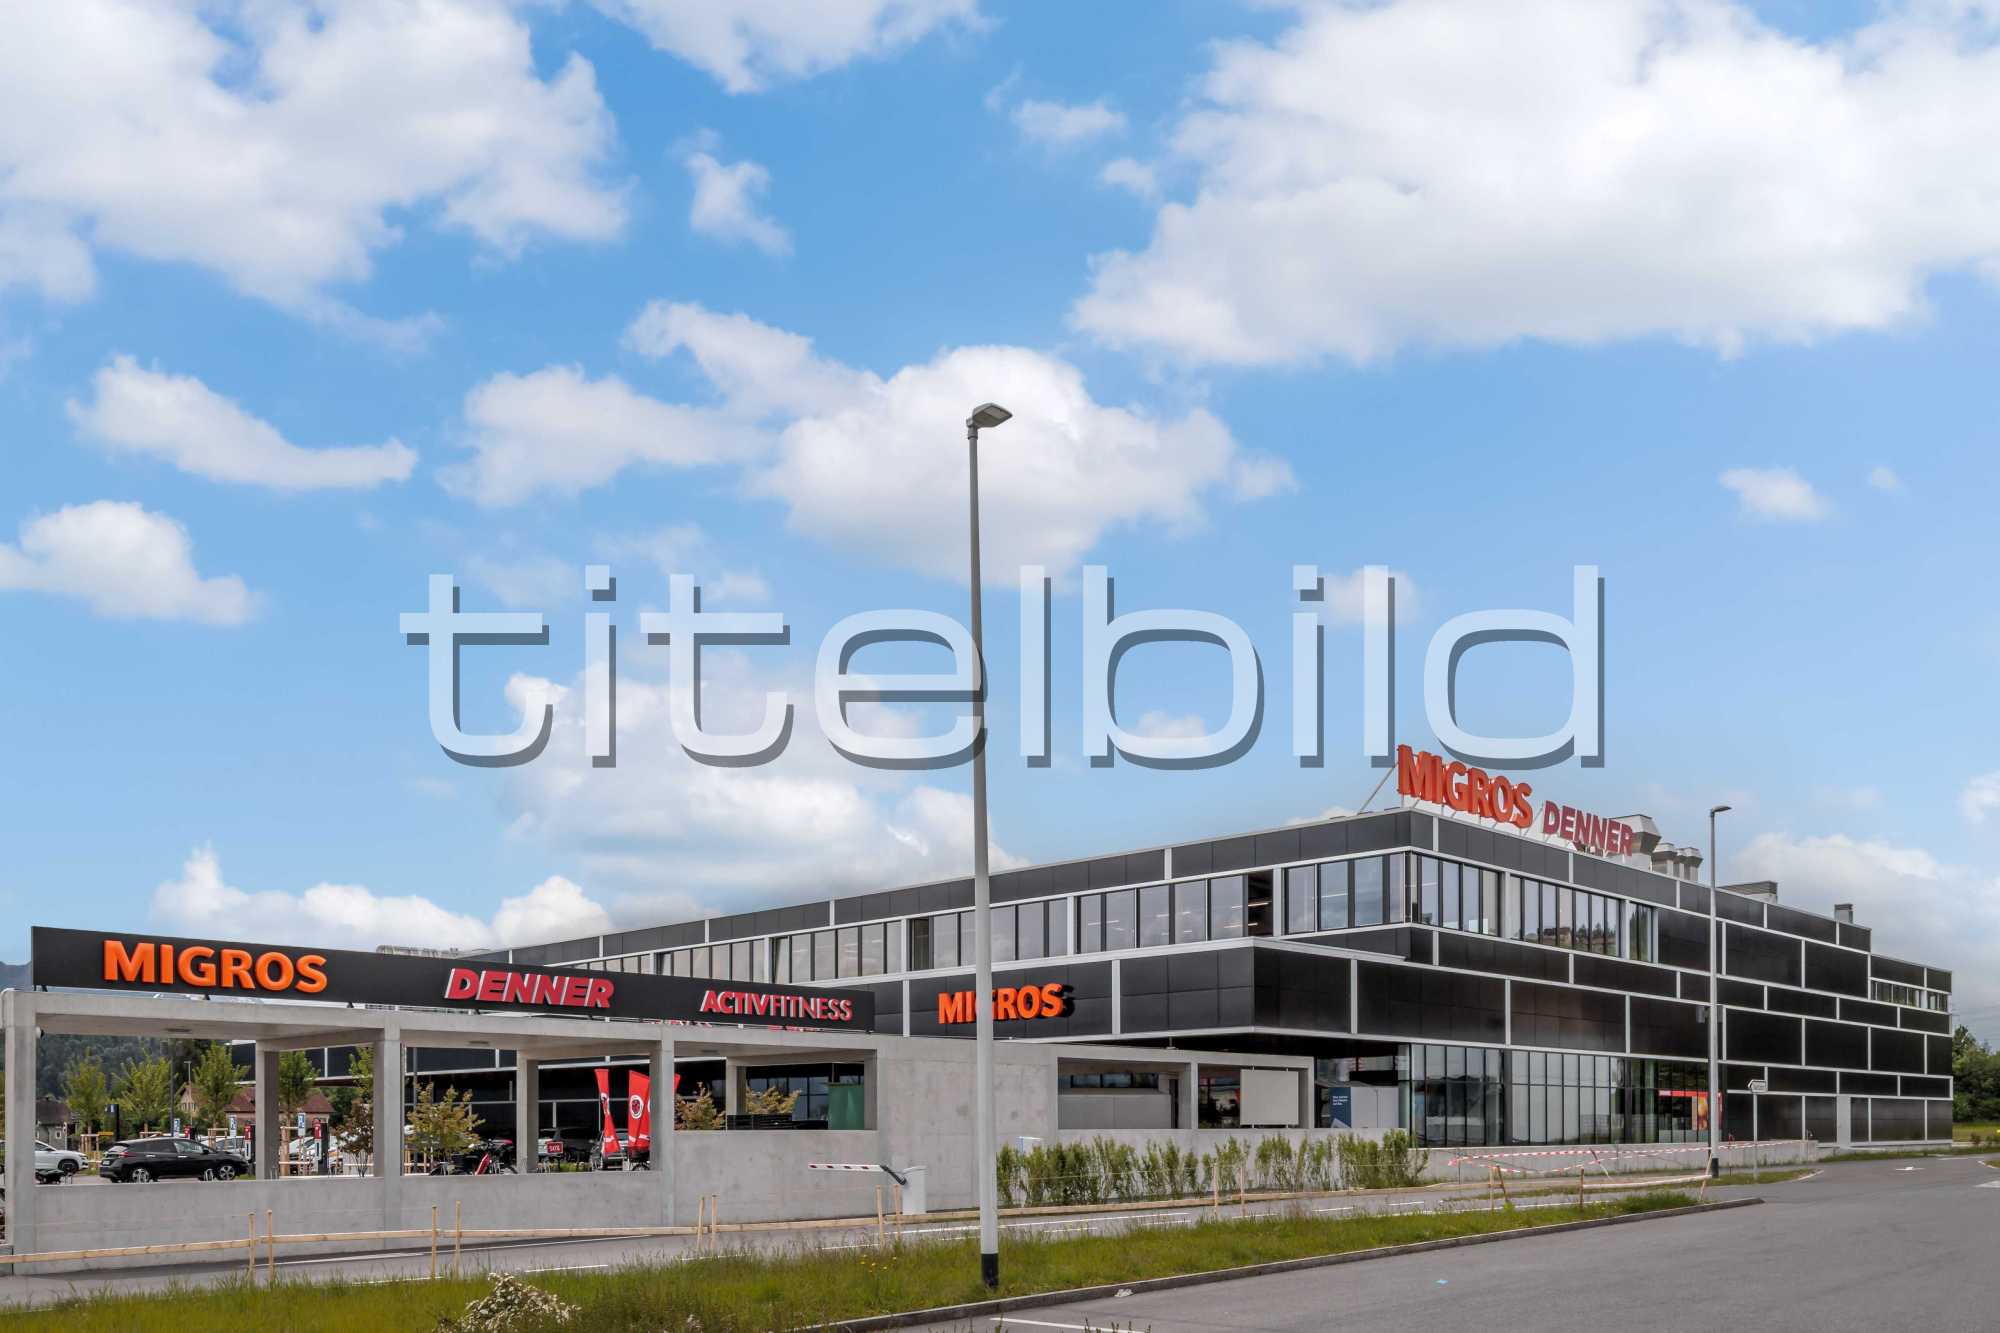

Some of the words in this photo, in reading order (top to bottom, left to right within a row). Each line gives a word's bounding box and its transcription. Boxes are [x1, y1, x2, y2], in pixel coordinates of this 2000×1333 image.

[1397, 744, 1533, 829] MIGROS
[1543, 800, 1636, 857] DENNER
[103, 939, 328, 993] MIGROS
[444, 967, 615, 1009] DENNER
[937, 982, 1064, 1025] MIROS
